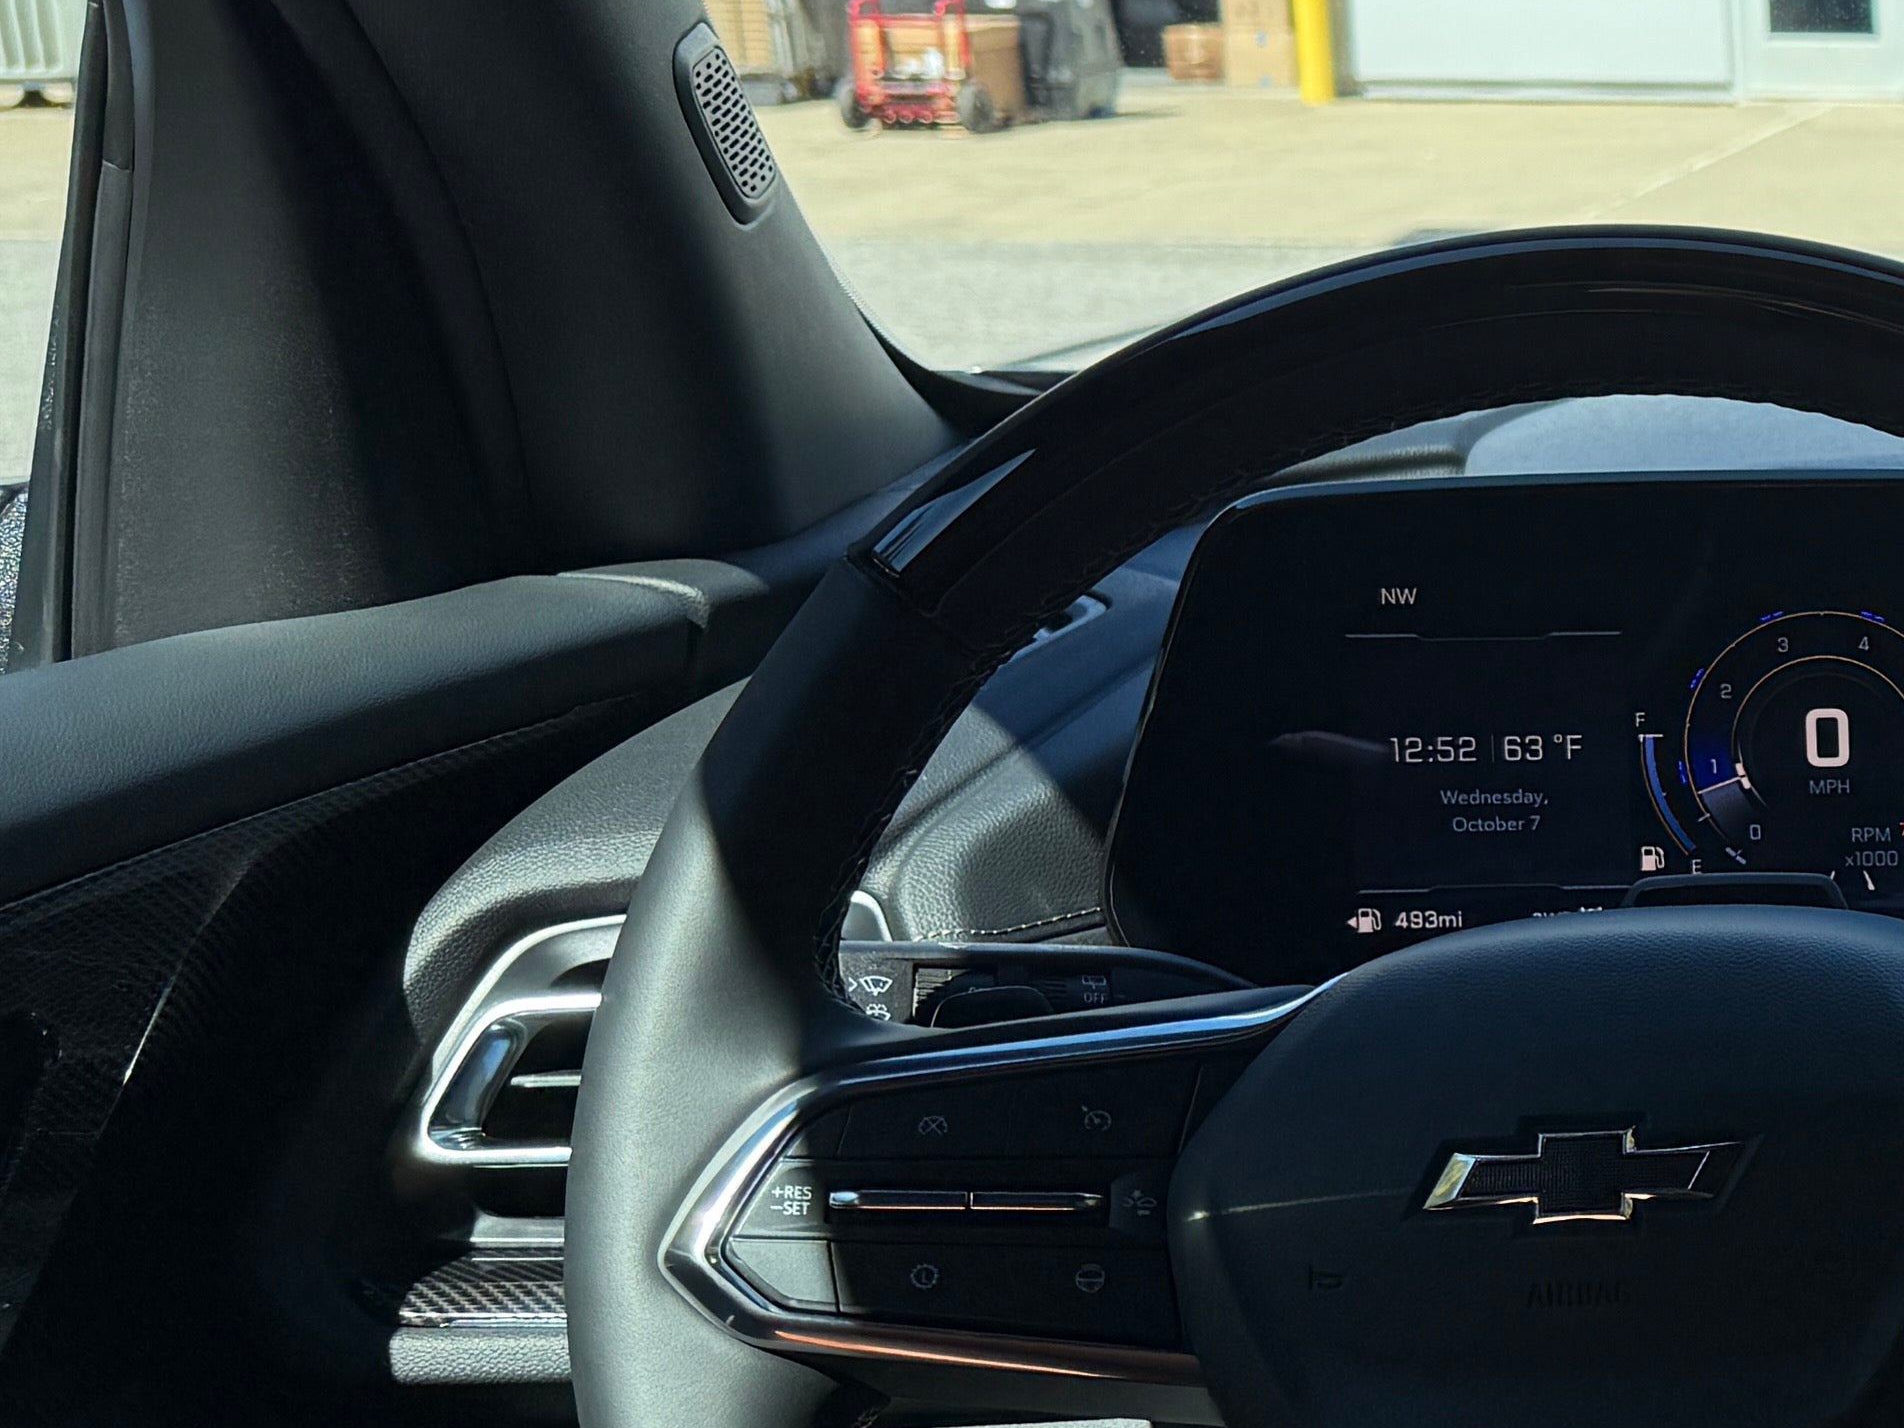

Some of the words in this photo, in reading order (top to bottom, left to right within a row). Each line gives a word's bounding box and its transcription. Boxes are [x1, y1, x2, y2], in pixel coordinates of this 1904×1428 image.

[1380, 587, 1417, 605] NW
[1776, 637, 1790, 653] 3
[1857, 637, 1871, 651] 4
[1720, 684, 1733, 699] 2
[1634, 712, 1646, 728] F
[1805, 708, 1850, 768] 0
[1389, 736, 1478, 763] 12:52
[1503, 735, 1544, 762] 63
[1553, 733, 1583, 760] °F
[1710, 758, 1718, 774] 1
[1810, 779, 1850, 795] MPH
[1440, 788, 1549, 808] Wednesday,
[1452, 816, 1525, 832] October
[1529, 814, 1541, 831] 7
[1750, 824, 1762, 840] 0
[1852, 827, 1891, 843] RPM
[1845, 850, 1898, 867] x1000
[1395, 910, 1463, 929] 493mi
[1083, 992, 1106, 1005] OFF
[1527, 1282, 1631, 1309] AIRBAG
